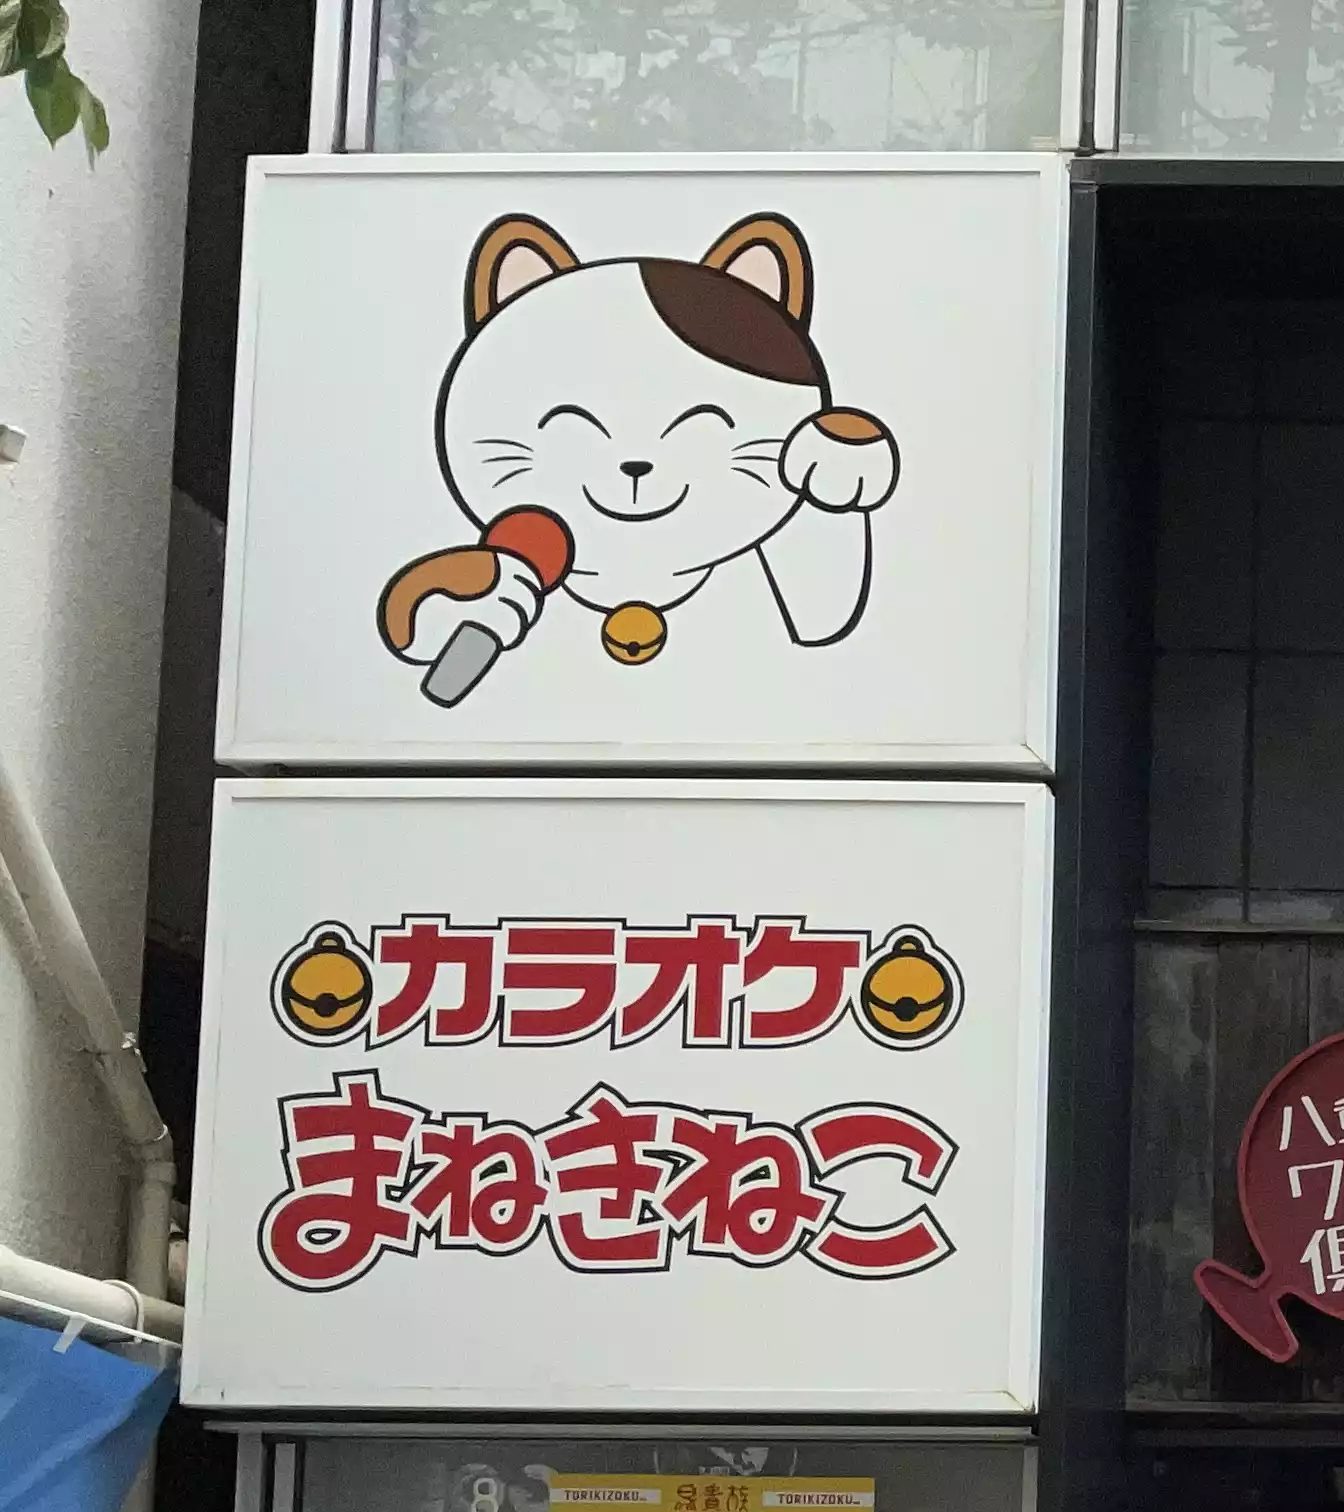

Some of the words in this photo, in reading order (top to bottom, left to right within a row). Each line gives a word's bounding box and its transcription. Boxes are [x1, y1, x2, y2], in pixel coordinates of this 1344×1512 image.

[370, 916, 866, 1048] カラオケ
[262, 1074, 956, 1287] まねきねこ
[564, 1489, 639, 1502] TORIKIZOKU
[778, 1493, 853, 1506] TORIKIZOKU
